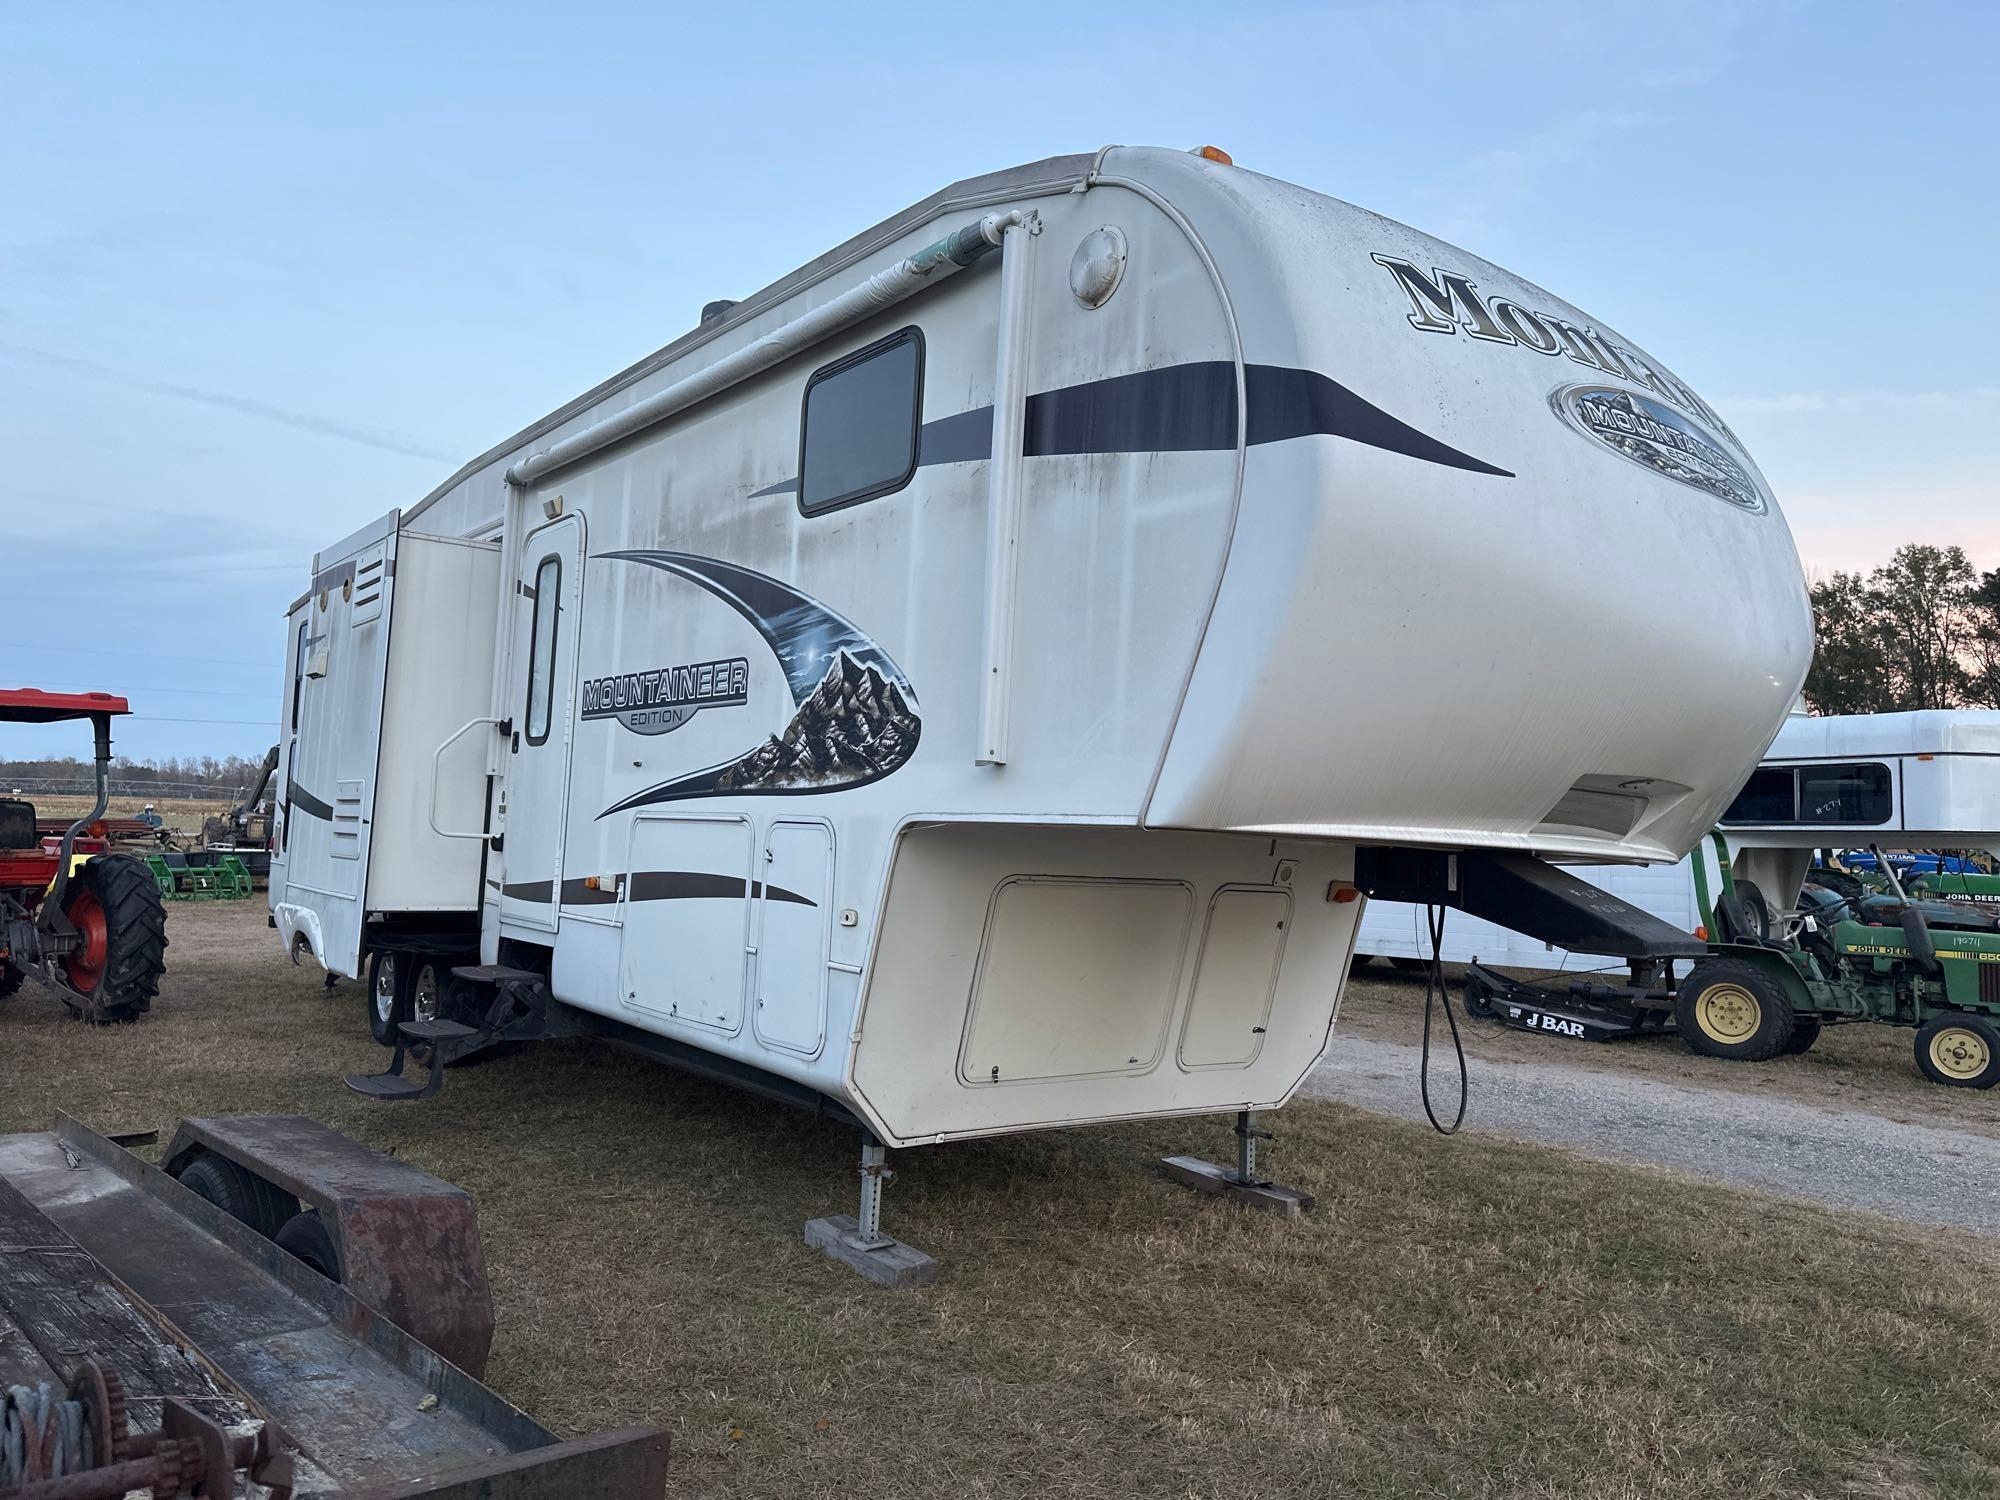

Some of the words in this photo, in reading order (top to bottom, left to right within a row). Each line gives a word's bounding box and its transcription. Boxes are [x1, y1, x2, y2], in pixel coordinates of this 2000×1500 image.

[582, 659, 748, 711] MOUNTAINEER
[630, 708, 683, 726] EDITION
[1945, 893, 1972, 901] JOHN
[1974, 894, 2000, 902] DEER
[1854, 944, 1880, 953] JOHN
[1885, 946, 1913, 955] DEER
[1526, 1013, 1540, 1027] J
[1541, 1015, 1585, 1036] BAR
